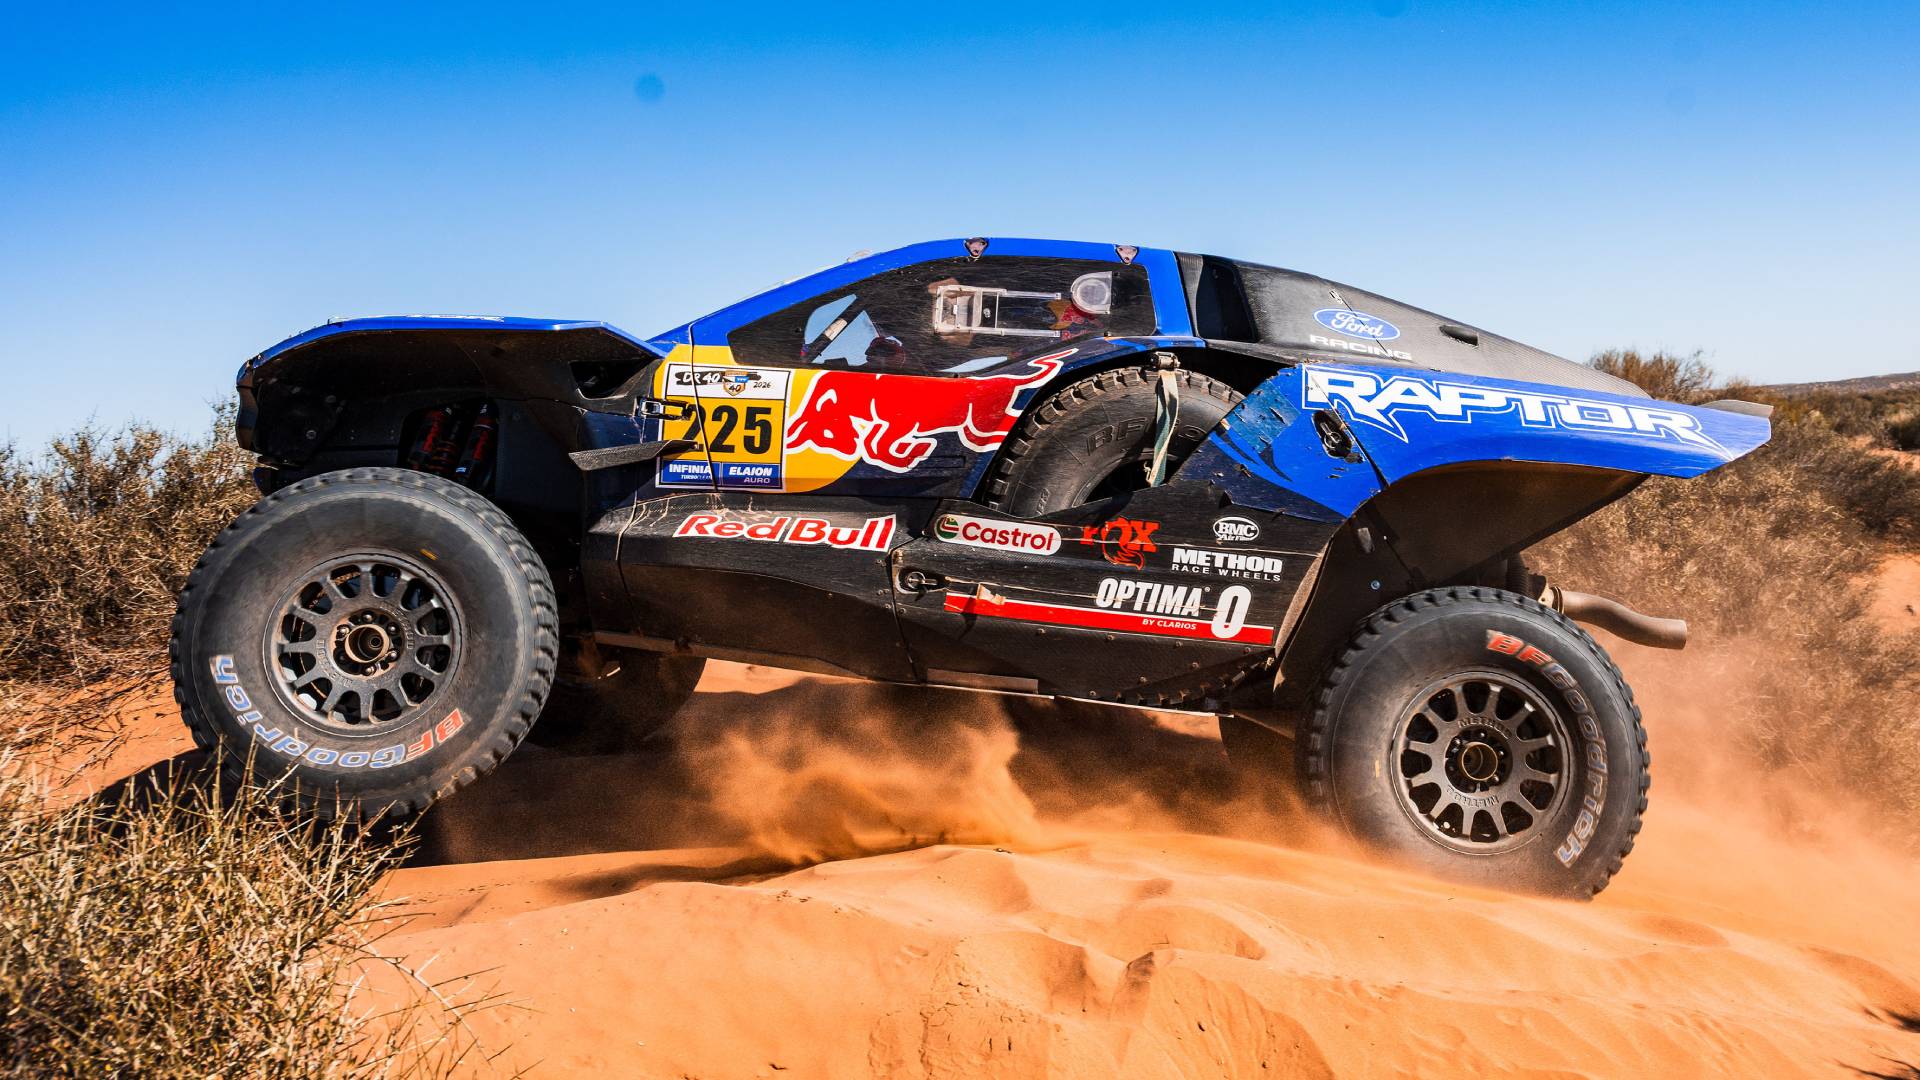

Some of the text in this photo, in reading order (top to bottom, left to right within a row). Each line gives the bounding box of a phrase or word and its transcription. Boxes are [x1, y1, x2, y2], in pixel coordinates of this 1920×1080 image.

[1330, 311, 1384, 337] Ford
[1309, 334, 1413, 360] RACING
[752, 381, 772, 389] 2026
[1303, 364, 1733, 460] RAPTOR
[681, 404, 773, 455] 225
[669, 463, 712, 474] INFINIA
[728, 466, 773, 477] ELAION
[674, 515, 895, 551] Red Bull
[961, 522, 1054, 551] Castrol
[1217, 522, 1257, 537] BMC
[1171, 564, 1281, 582] RACE WHEELS
[1172, 547, 1284, 575] METHOD
[1142, 618, 1198, 630] BY CLARIOS
[208, 654, 466, 769] BFGoodrich
[1486, 632, 1609, 869] BFGoodrich
